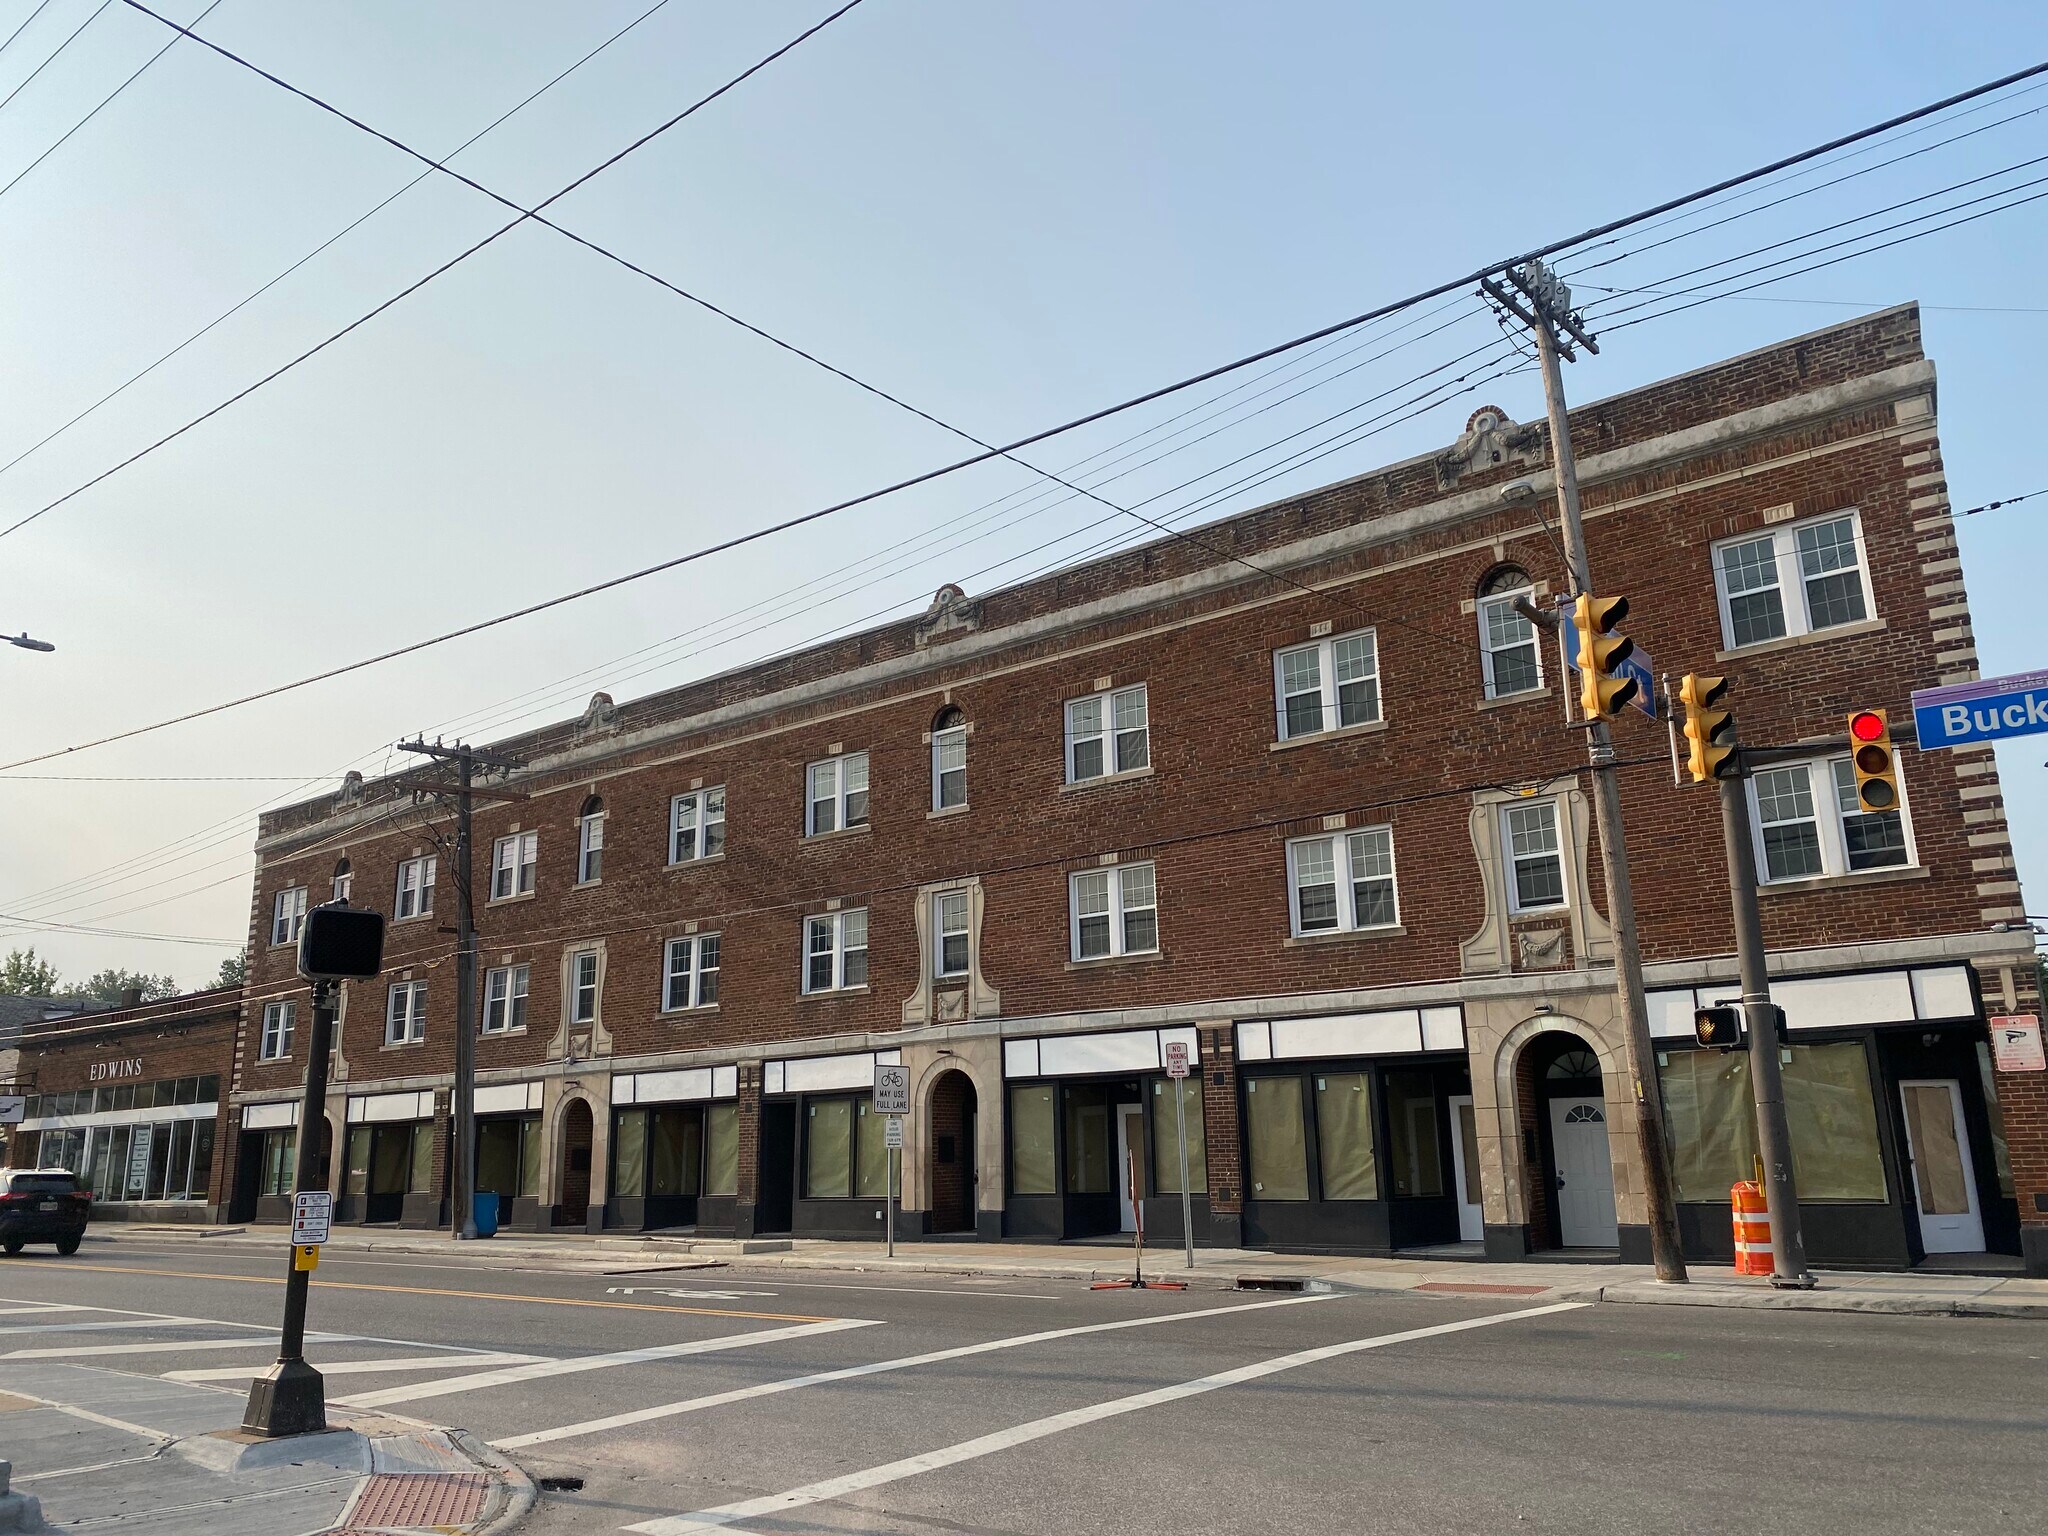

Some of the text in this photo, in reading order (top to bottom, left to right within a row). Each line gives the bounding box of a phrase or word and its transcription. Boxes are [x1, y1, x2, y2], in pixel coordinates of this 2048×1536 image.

[1942, 693, 2048, 737] Buck
[1172, 1045, 1182, 1053] NO
[90, 1058, 142, 1081] EDWINS
[879, 1090, 904, 1099] MAY USE
[876, 1100, 907, 1109] FULL LANE
